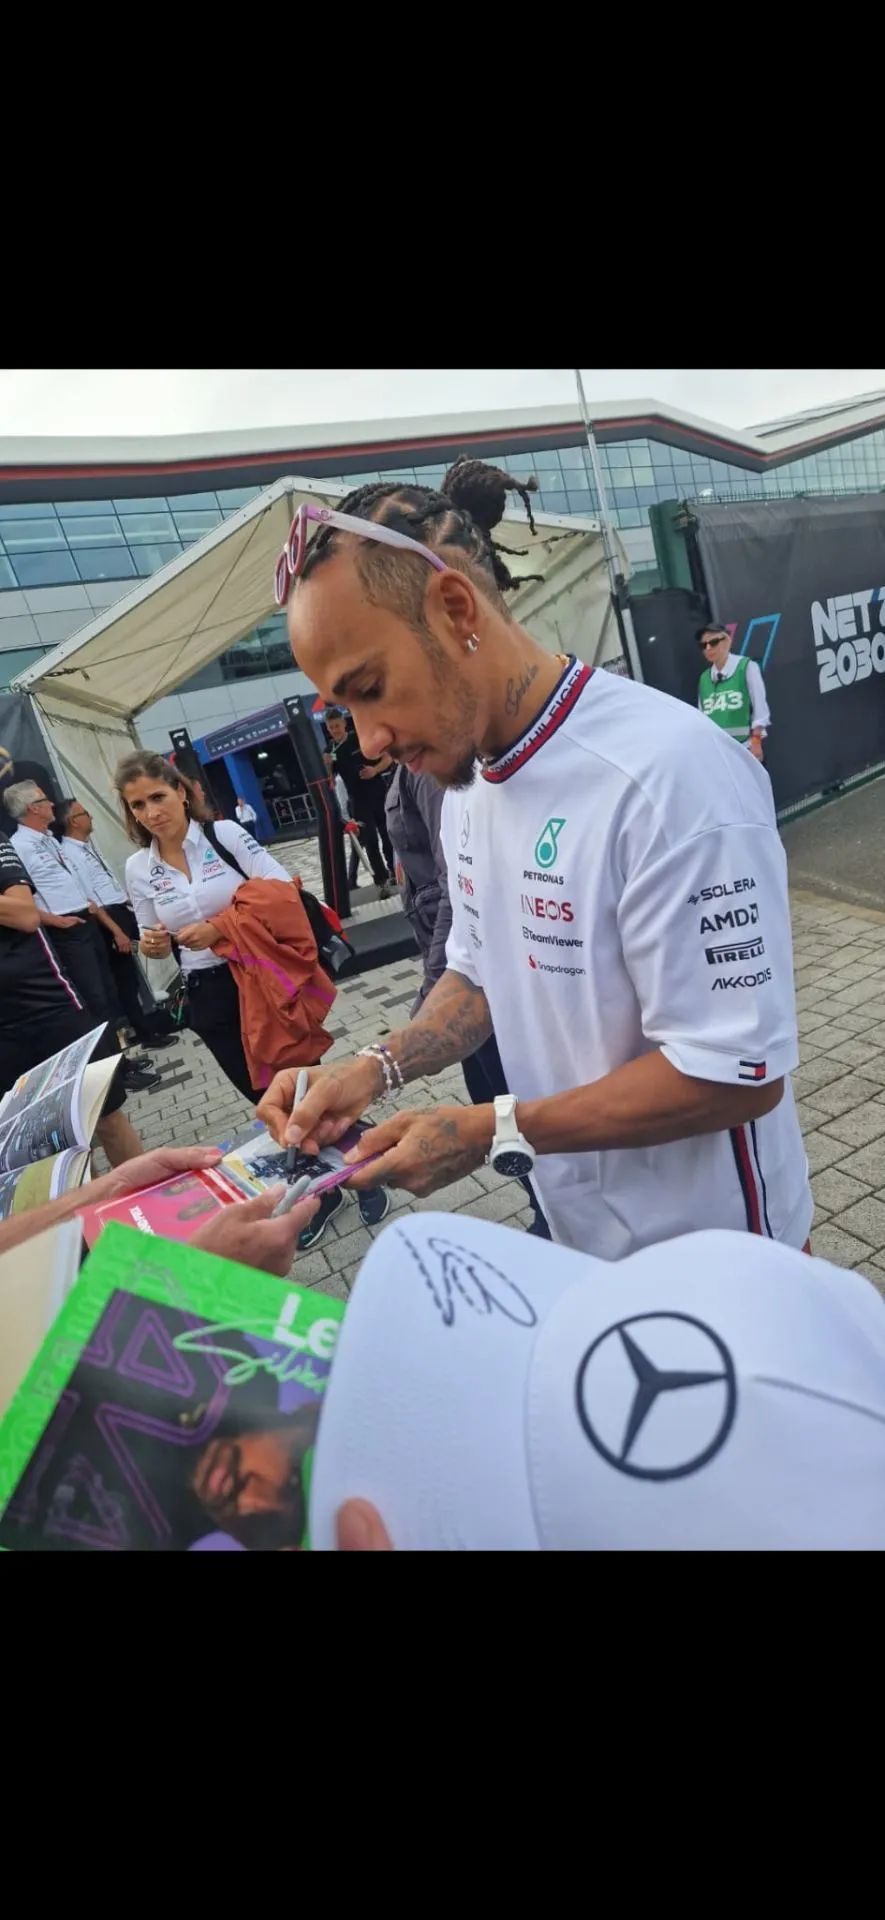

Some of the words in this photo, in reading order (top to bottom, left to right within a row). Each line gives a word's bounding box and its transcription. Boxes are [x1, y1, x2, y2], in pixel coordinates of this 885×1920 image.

[811, 588, 873, 646] NET
[816, 632, 885, 694] 2030
[703, 691, 744, 715] 343
[523, 870, 565, 886] PETRONAS
[700, 877, 756, 902] SOLERA
[520, 894, 574, 923] INEOS
[699, 908, 749, 935] AMD
[529, 930, 584, 949] TeamViewer
[705, 936, 765, 965] PIRELLI
[537, 960, 586, 977] Snapdragon
